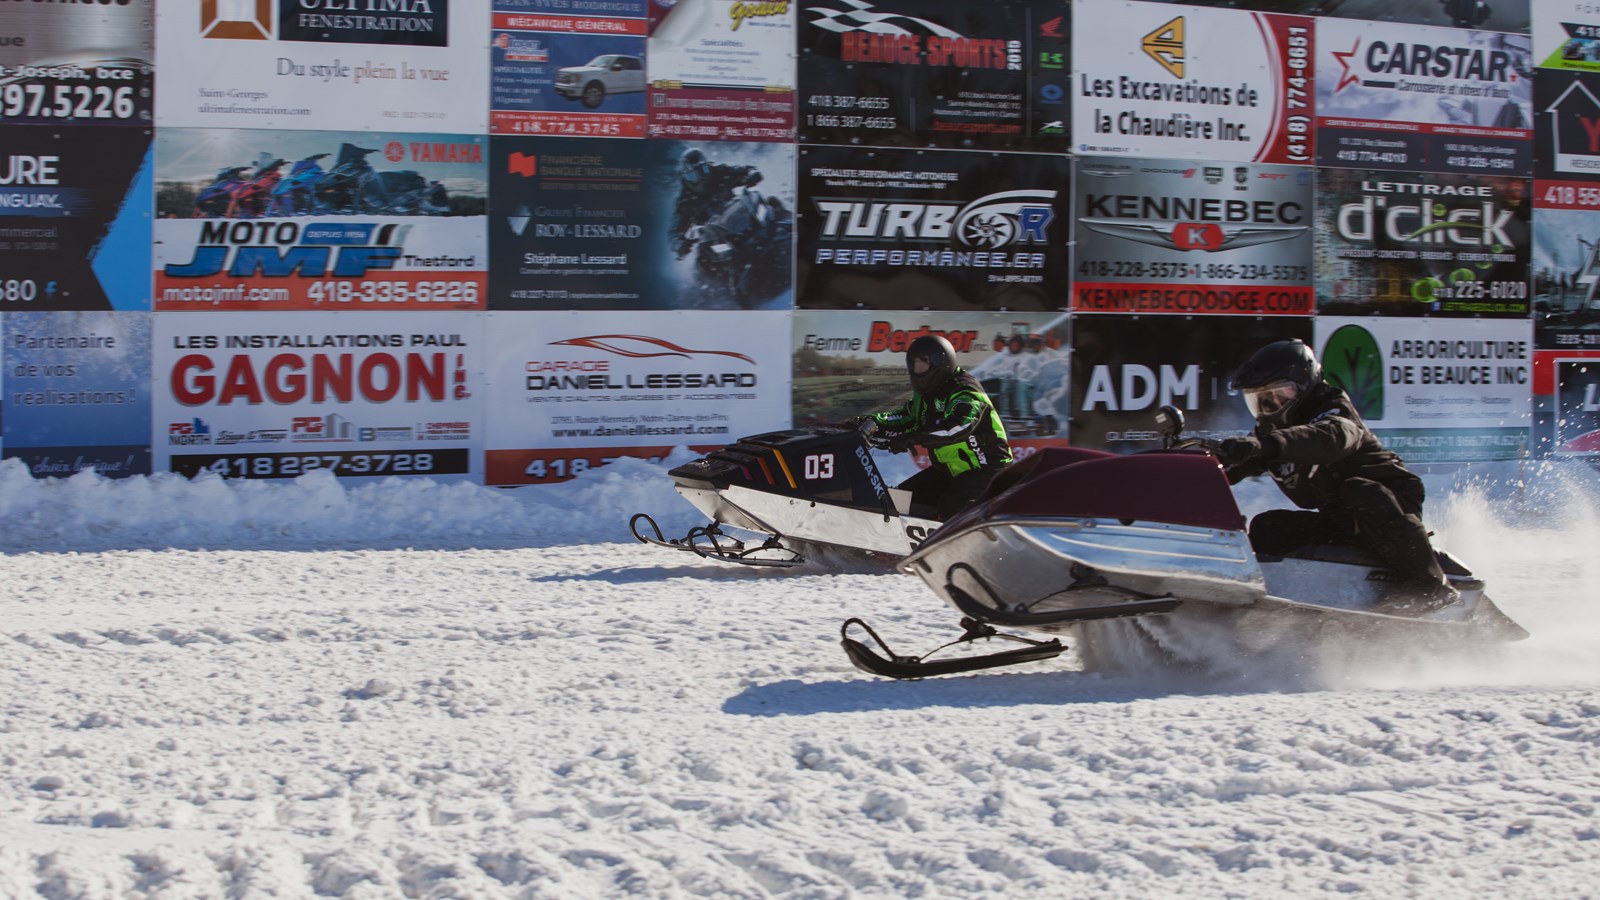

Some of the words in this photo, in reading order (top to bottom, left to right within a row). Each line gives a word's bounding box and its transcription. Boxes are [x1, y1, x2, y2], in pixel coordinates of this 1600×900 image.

[299, 13, 433, 32] FENESTRATION
[841, 31, 921, 64] BEAUCE
[927, 36, 1006, 69] SPORTS
[277, 58, 305, 76] Du
[309, 59, 349, 82] style
[354, 61, 396, 83] plein
[400, 61, 416, 80] la
[420, 68, 450, 81] vue
[1287, 26, 1308, 108] 774-6651
[1366, 40, 1510, 82] CARSTAR
[96, 66, 134, 80] bce
[1081, 73, 1114, 98] Les
[1119, 75, 1232, 107] Excavations
[1236, 83, 1258, 107] de
[0, 84, 135, 119] 97.5226
[808, 94, 831, 107] 418
[832, 95, 890, 109] 387-6655
[806, 115, 813, 126] 1
[815, 115, 840, 127] 866
[840, 116, 896, 129] 387-6655
[1095, 108, 1112, 134] la
[1118, 110, 1213, 139] Chaudière
[1217, 117, 1251, 142] Inc.
[1287, 116, 1311, 160] (418)
[409, 142, 483, 163] YAMAHA
[1361, 181, 1493, 197] LETTRAGE
[1544, 186, 1575, 204] 418
[1086, 194, 1304, 225] KENNEBEC
[1337, 194, 1515, 248] d'click
[201, 221, 299, 245] MOTO
[1188, 227, 1210, 246] K
[164, 245, 404, 278] JMF
[404, 254, 476, 268] Thetford
[523, 252, 579, 266] Stéphane
[581, 254, 628, 264] Lessard
[815, 248, 1046, 269] PERFORMANCE.CA
[1079, 261, 1188, 279] 418-228-5575
[1194, 263, 1309, 281] 1-866-234-5575
[164, 284, 290, 305] motojmf.com
[307, 281, 480, 303] 418-335-6226
[1080, 288, 1309, 312] KENNEBECDODGE.COM
[1455, 280, 1528, 299] 225-6020
[14, 332, 116, 349] Partenaire
[173, 335, 218, 349] LES
[225, 334, 403, 348] INSTALLATIONS
[410, 333, 468, 347] PAUL
[804, 335, 862, 351] Ferme
[866, 321, 977, 353] Beror
[1390, 340, 1528, 359] ARBORICULTURE
[14, 362, 38, 377] de
[43, 364, 76, 378] vos
[526, 361, 610, 372] GARAGE
[1390, 366, 1415, 385] DE
[1421, 366, 1493, 385] BEAUCE
[1498, 366, 1528, 385] INC
[170, 351, 446, 406] GAGNON
[526, 374, 622, 391] DANIEL
[626, 372, 757, 389] LESSARD
[1081, 364, 1200, 411] ADM
[14, 387, 125, 405] réalisations
[552, 423, 729, 438] www.daniellessard.com
[211, 457, 274, 475] 418
[279, 453, 434, 474] 227-3728
[804, 454, 834, 479] 03
